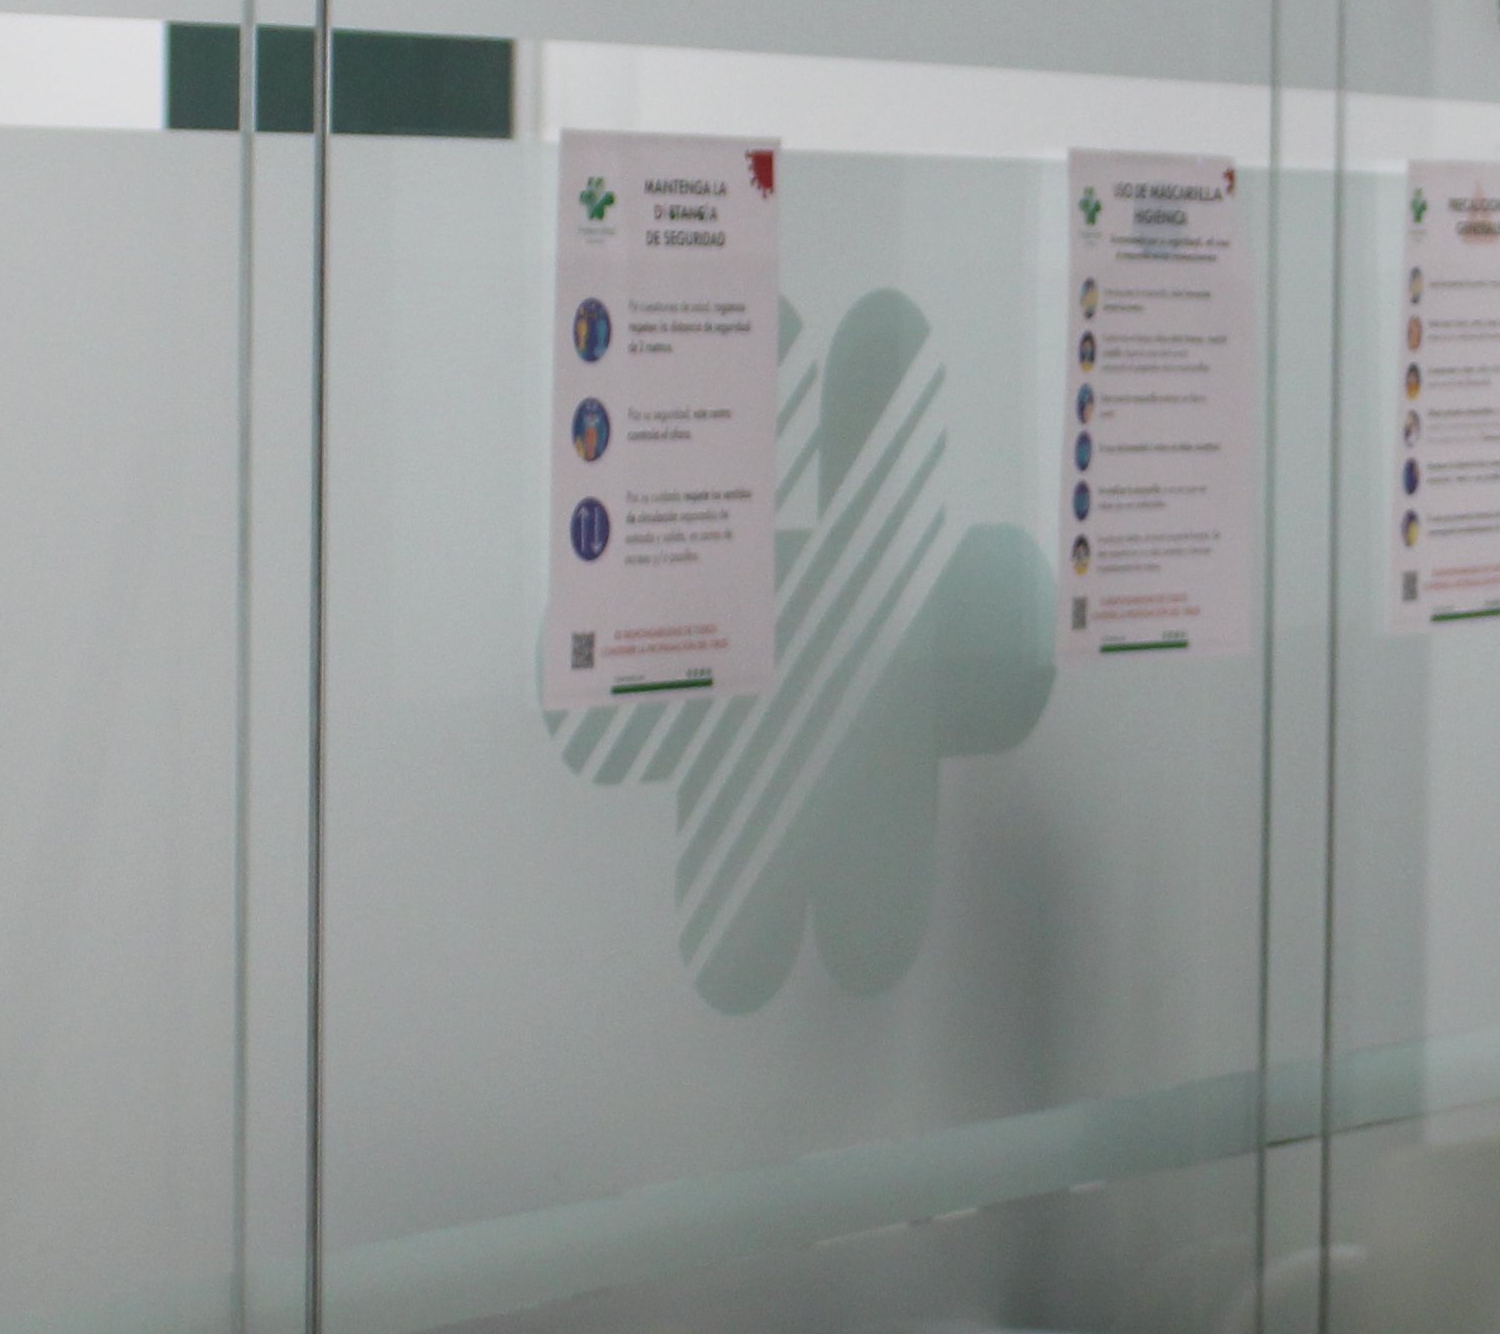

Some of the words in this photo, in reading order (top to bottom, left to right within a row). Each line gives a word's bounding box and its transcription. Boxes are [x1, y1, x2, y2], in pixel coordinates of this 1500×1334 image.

[643, 178, 711, 196] MANTENGA
[713, 180, 727, 196] LA
[646, 229, 661, 247] DE
[663, 230, 726, 247] SEGURIDAD
